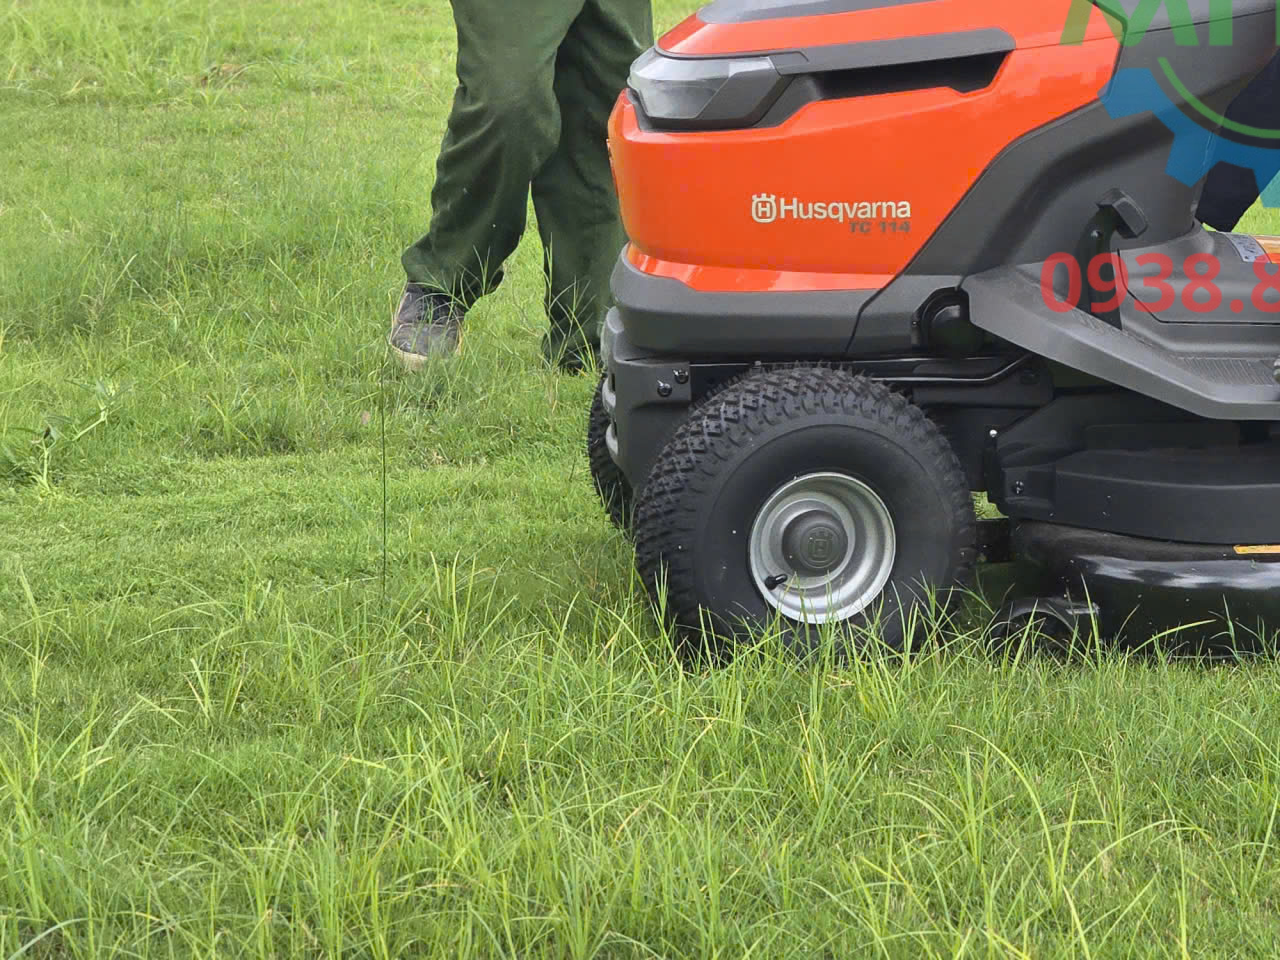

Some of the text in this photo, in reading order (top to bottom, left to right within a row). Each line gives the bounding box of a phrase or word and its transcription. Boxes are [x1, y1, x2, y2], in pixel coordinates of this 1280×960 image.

[780, 197, 911, 223] Husqvarna
[851, 221, 910, 233] TC 114
